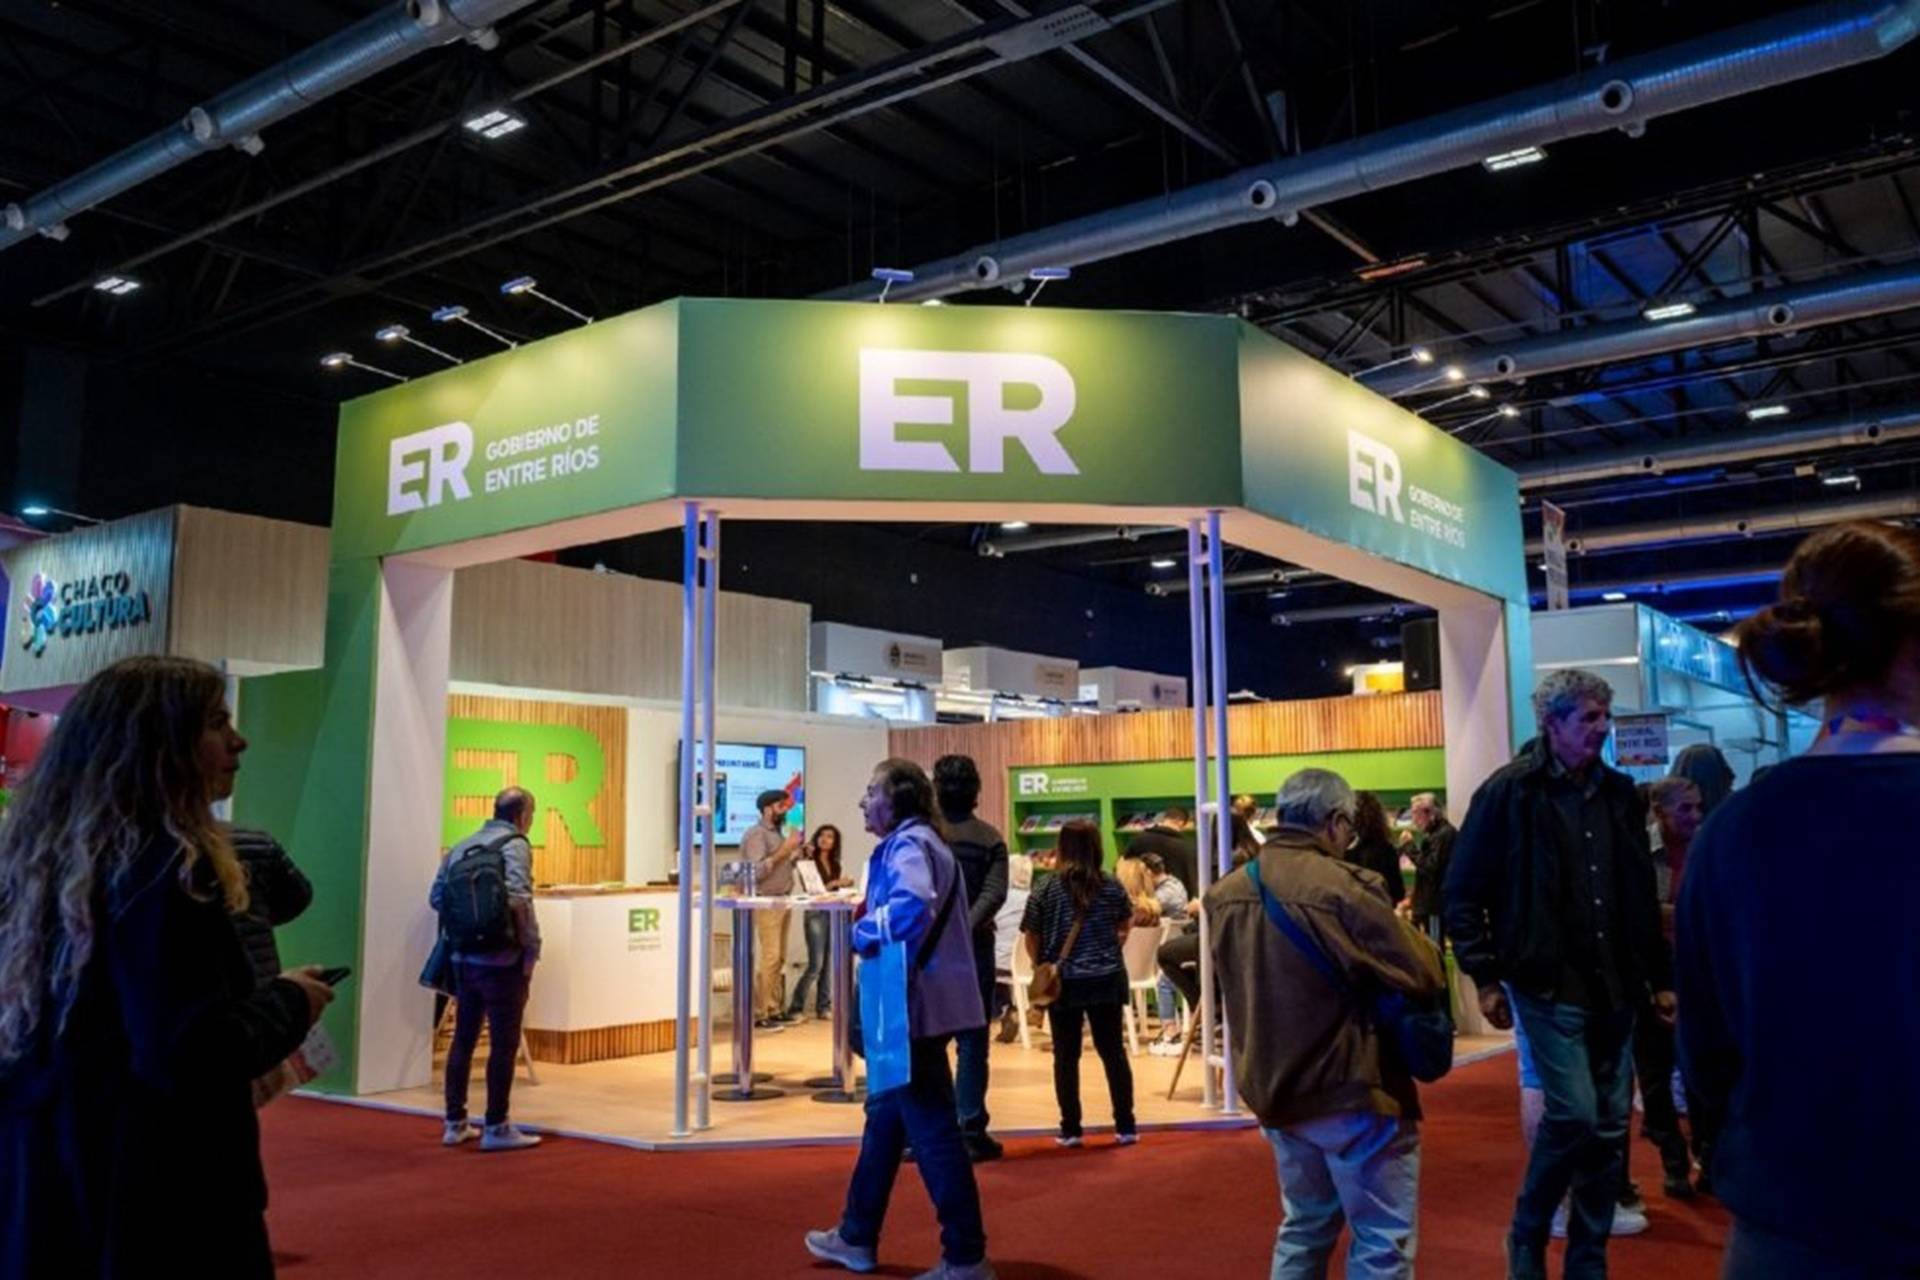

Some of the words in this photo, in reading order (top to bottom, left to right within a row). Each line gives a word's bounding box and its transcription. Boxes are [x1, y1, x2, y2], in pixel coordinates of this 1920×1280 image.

[858, 348, 1081, 475] ER
[485, 422, 572, 461] GOBIERNO
[575, 414, 599, 438] DE
[387, 421, 472, 515] ER
[485, 458, 547, 492] ENTRE
[551, 446, 600, 477] RÍOS
[1347, 428, 1405, 524] ER
[61, 571, 131, 606] CHACO
[58, 592, 150, 637] CULTURA
[442, 717, 606, 848] ER
[1019, 772, 1049, 795] ER
[629, 909, 660, 932] ER
